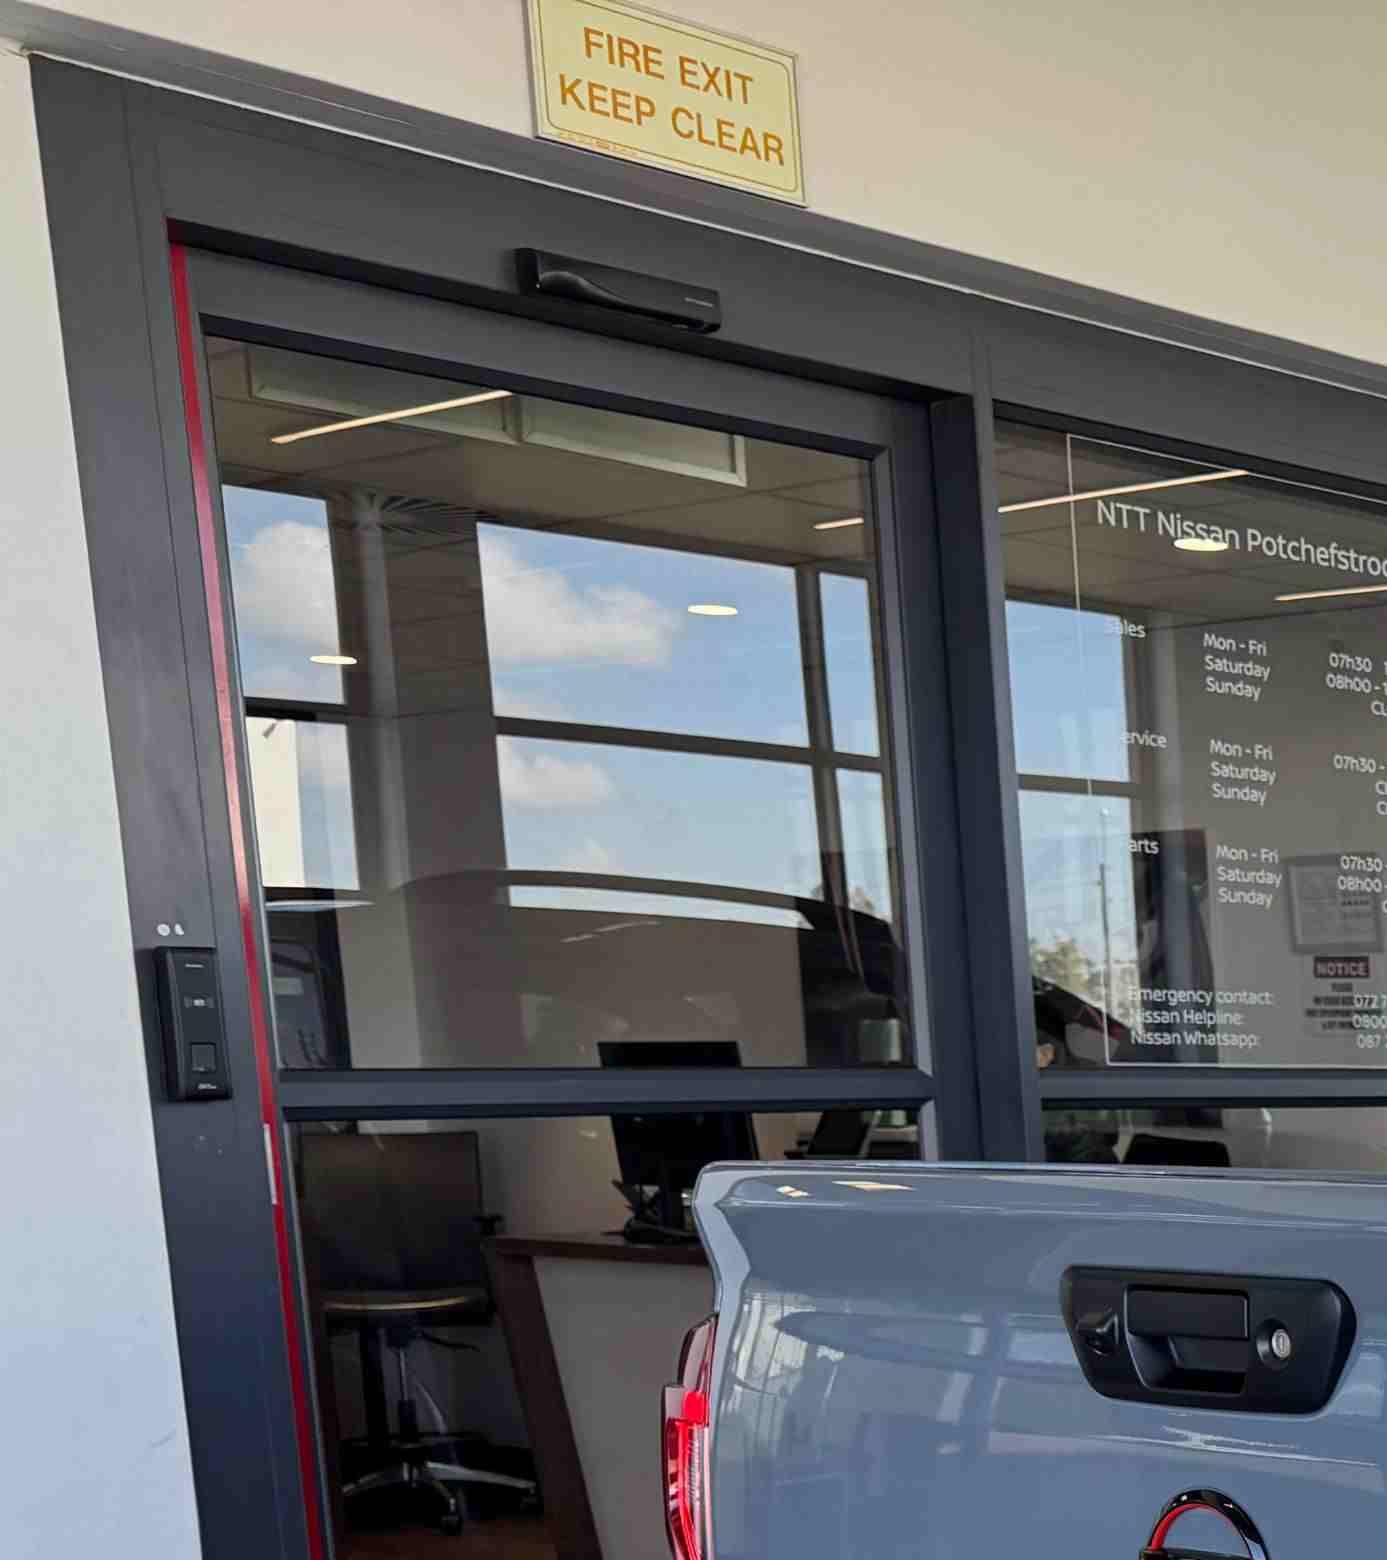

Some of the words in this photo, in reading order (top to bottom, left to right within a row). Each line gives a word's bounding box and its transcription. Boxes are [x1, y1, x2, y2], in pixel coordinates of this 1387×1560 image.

[583, 26, 665, 80] FIRE
[678, 55, 753, 105] EXIT
[559, 73, 656, 126] KEEP
[671, 106, 784, 166] CLEAR
[1097, 499, 1150, 532] NTT
[1157, 510, 1240, 550] Nissan
[1203, 632, 1237, 652] Mon
[1249, 639, 1267, 657] Fri
[1204, 654, 1271, 682] Saturday
[1329, 652, 1373, 673] 07h30
[1205, 675, 1261, 702] Sunday
[1325, 673, 1372, 694] 08h00
[1119, 729, 1168, 749] ervice
[1209, 738, 1243, 758] Mon
[1254, 743, 1273, 761] Fri
[1210, 760, 1276, 786] Saturday
[1334, 754, 1377, 774] 07h30
[1211, 782, 1267, 808] Sunday
[1127, 837, 1160, 855] arts
[1216, 844, 1249, 862] Mon
[1260, 848, 1279, 865] Fri
[1340, 854, 1383, 873] 07h30
[1216, 865, 1283, 889] Saturday
[1218, 886, 1273, 911] Sunday
[1316, 961, 1368, 977] NOTICE
[1128, 986, 1213, 1006] Emergency
[1131, 1028, 1181, 1045] Nissan
